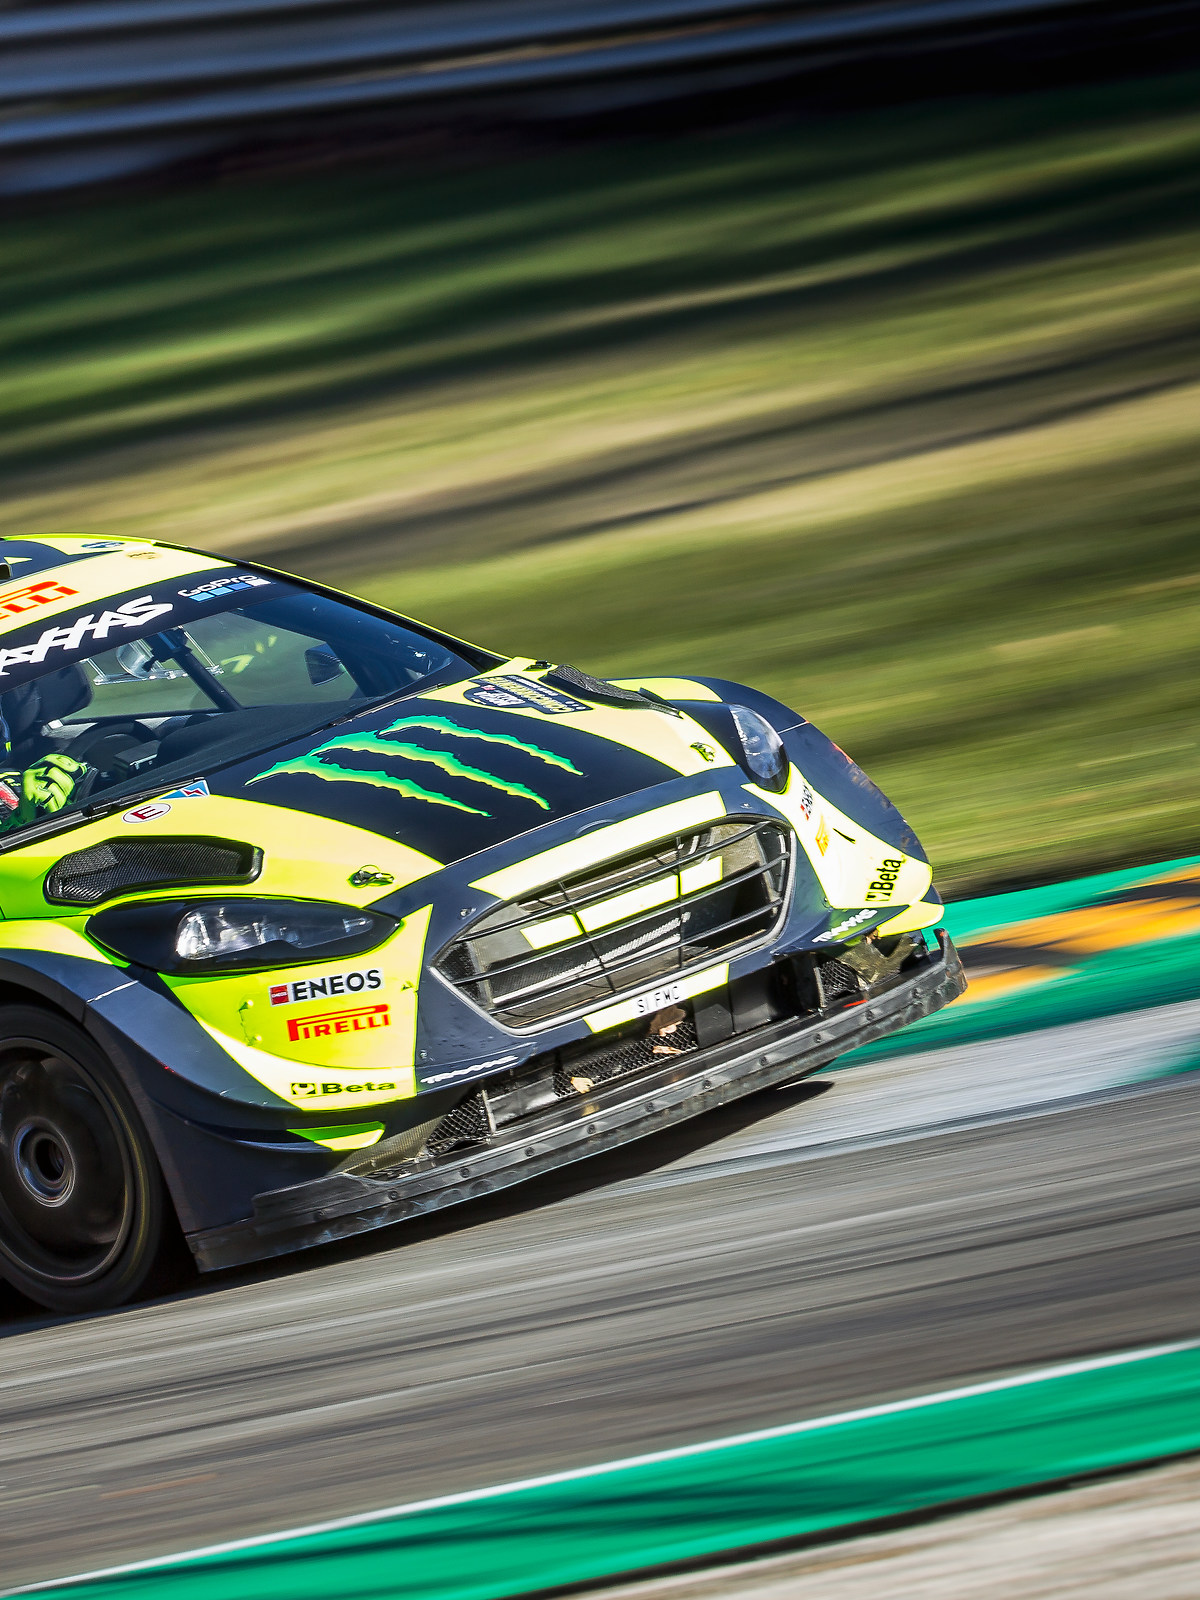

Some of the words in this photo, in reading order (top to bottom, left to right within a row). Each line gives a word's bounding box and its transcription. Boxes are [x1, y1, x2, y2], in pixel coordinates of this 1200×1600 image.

[176, 574, 259, 598] GoPro
[130, 805, 164, 820] E
[868, 858, 902, 891] Beta
[291, 969, 382, 1002] ENEOS
[287, 1003, 390, 1042] PIRELLI
[321, 1081, 397, 1095] Beta
